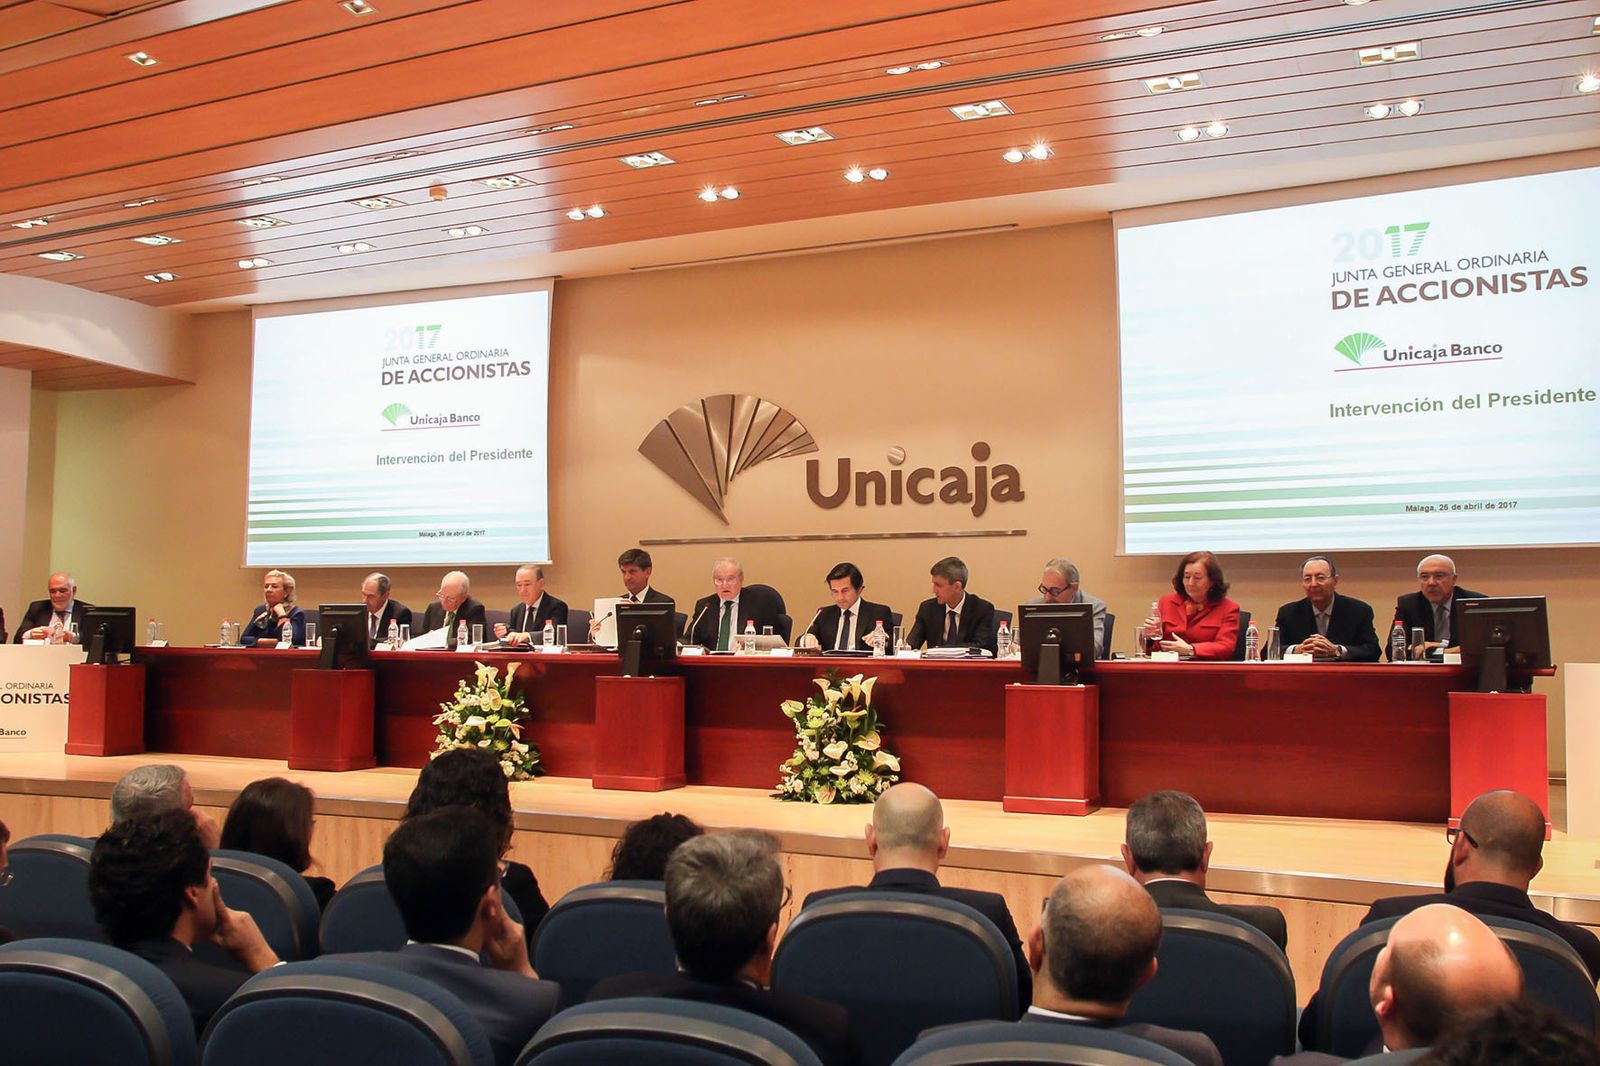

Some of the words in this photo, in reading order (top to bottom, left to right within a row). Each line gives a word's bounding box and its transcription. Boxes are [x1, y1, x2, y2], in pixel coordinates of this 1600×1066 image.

[1333, 222, 1431, 263] 2017
[1331, 269, 1378, 288] JUNTA
[1383, 261, 1452, 279] GENERAL
[1457, 250, 1549, 271] ORDINARIA
[1331, 288, 1369, 310] DE
[1376, 266, 1589, 306] ACCIONISTAS
[384, 324, 442, 351] 2017
[382, 356, 410, 369] JUNTA
[413, 353, 453, 364] GENERAL
[456, 348, 510, 361] ORDINARIA
[1383, 343, 1448, 362] Unicaja
[1450, 343, 1503, 357] Banco
[381, 370, 404, 386] DE
[407, 361, 531, 384] ACCIONISTAS
[1330, 397, 1444, 418] Intervención
[1451, 394, 1481, 410] del
[1488, 387, 1597, 408] Presidente
[410, 414, 448, 426] Unicaja
[449, 413, 480, 423] Banco
[376, 452, 444, 466] Intervención
[449, 450, 466, 462] del
[470, 448, 533, 462] Presidente
[806, 441, 1025, 518] Unicaja
[1451, 503, 1461, 511] de
[1464, 502, 1483, 510] abril
[1485, 501, 1495, 509] de
[1498, 501, 1518, 509] 2017
[5, 682, 54, 690] ORDINARIA
[0, 728, 27, 736] Banco
